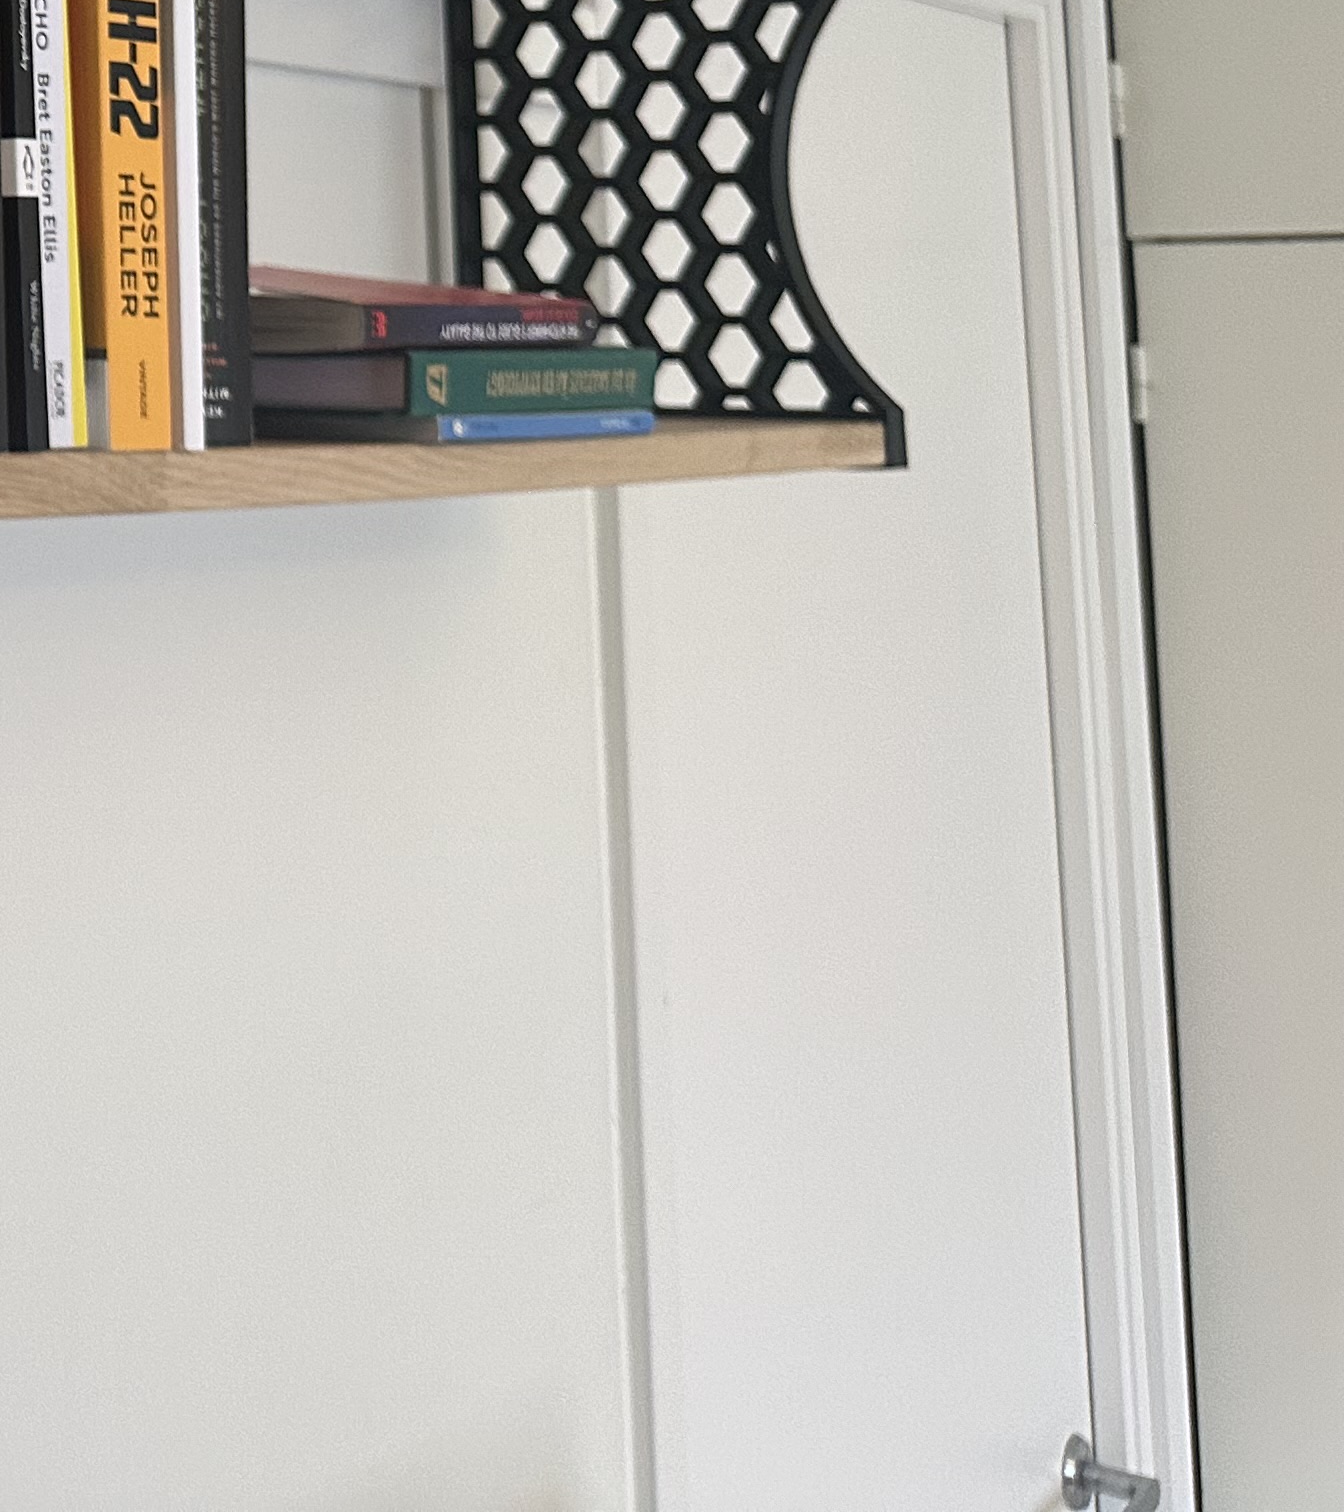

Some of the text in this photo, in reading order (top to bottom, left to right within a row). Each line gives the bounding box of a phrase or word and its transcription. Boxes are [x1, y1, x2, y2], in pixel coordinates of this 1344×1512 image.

[37, 72, 51, 122] Bret
[39, 129, 53, 205] Easton
[43, 215, 58, 264] Ellis
[118, 172, 138, 317] HELLER
[140, 172, 160, 319] JOSEPH
